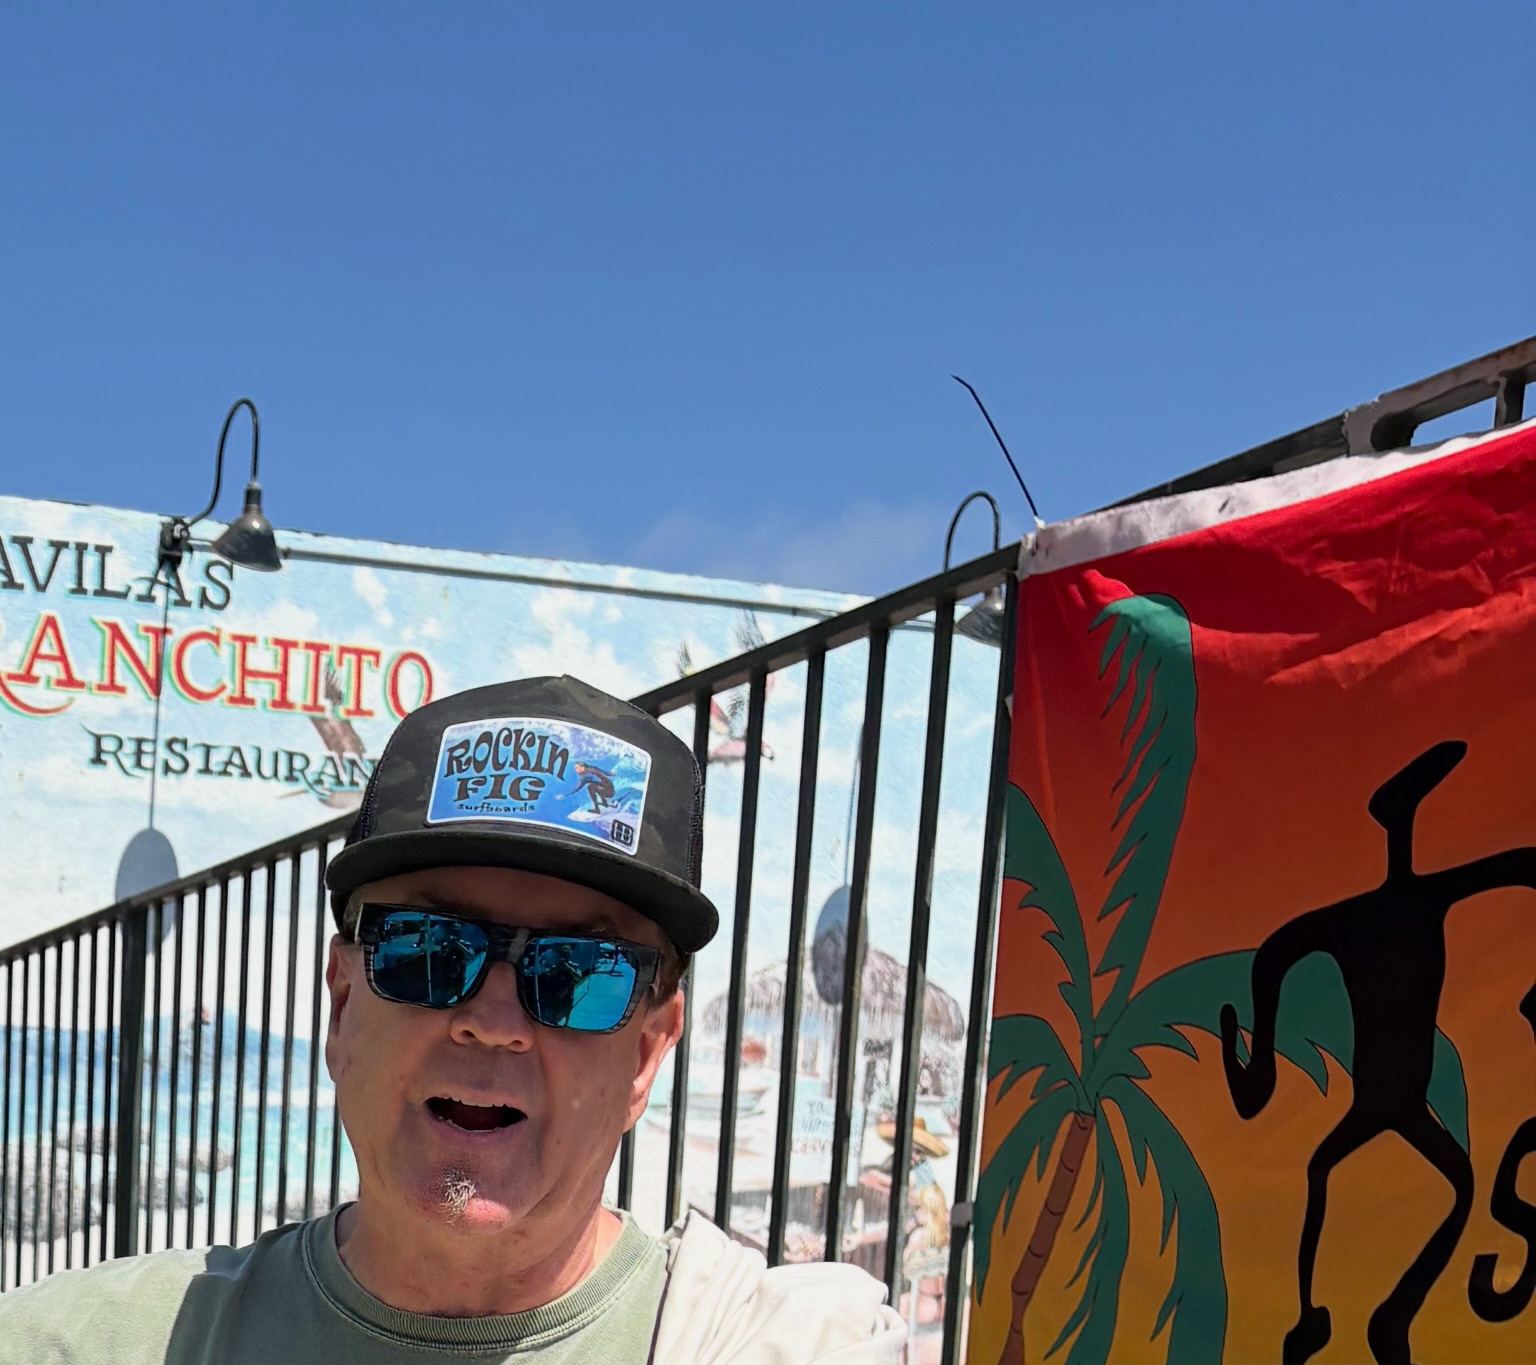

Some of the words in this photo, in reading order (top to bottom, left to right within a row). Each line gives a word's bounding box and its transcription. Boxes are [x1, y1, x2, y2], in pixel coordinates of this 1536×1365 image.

[79, 722, 381, 800] RESTAURAN
[454, 773, 546, 803] FIG
[456, 801, 536, 813] surfboards
